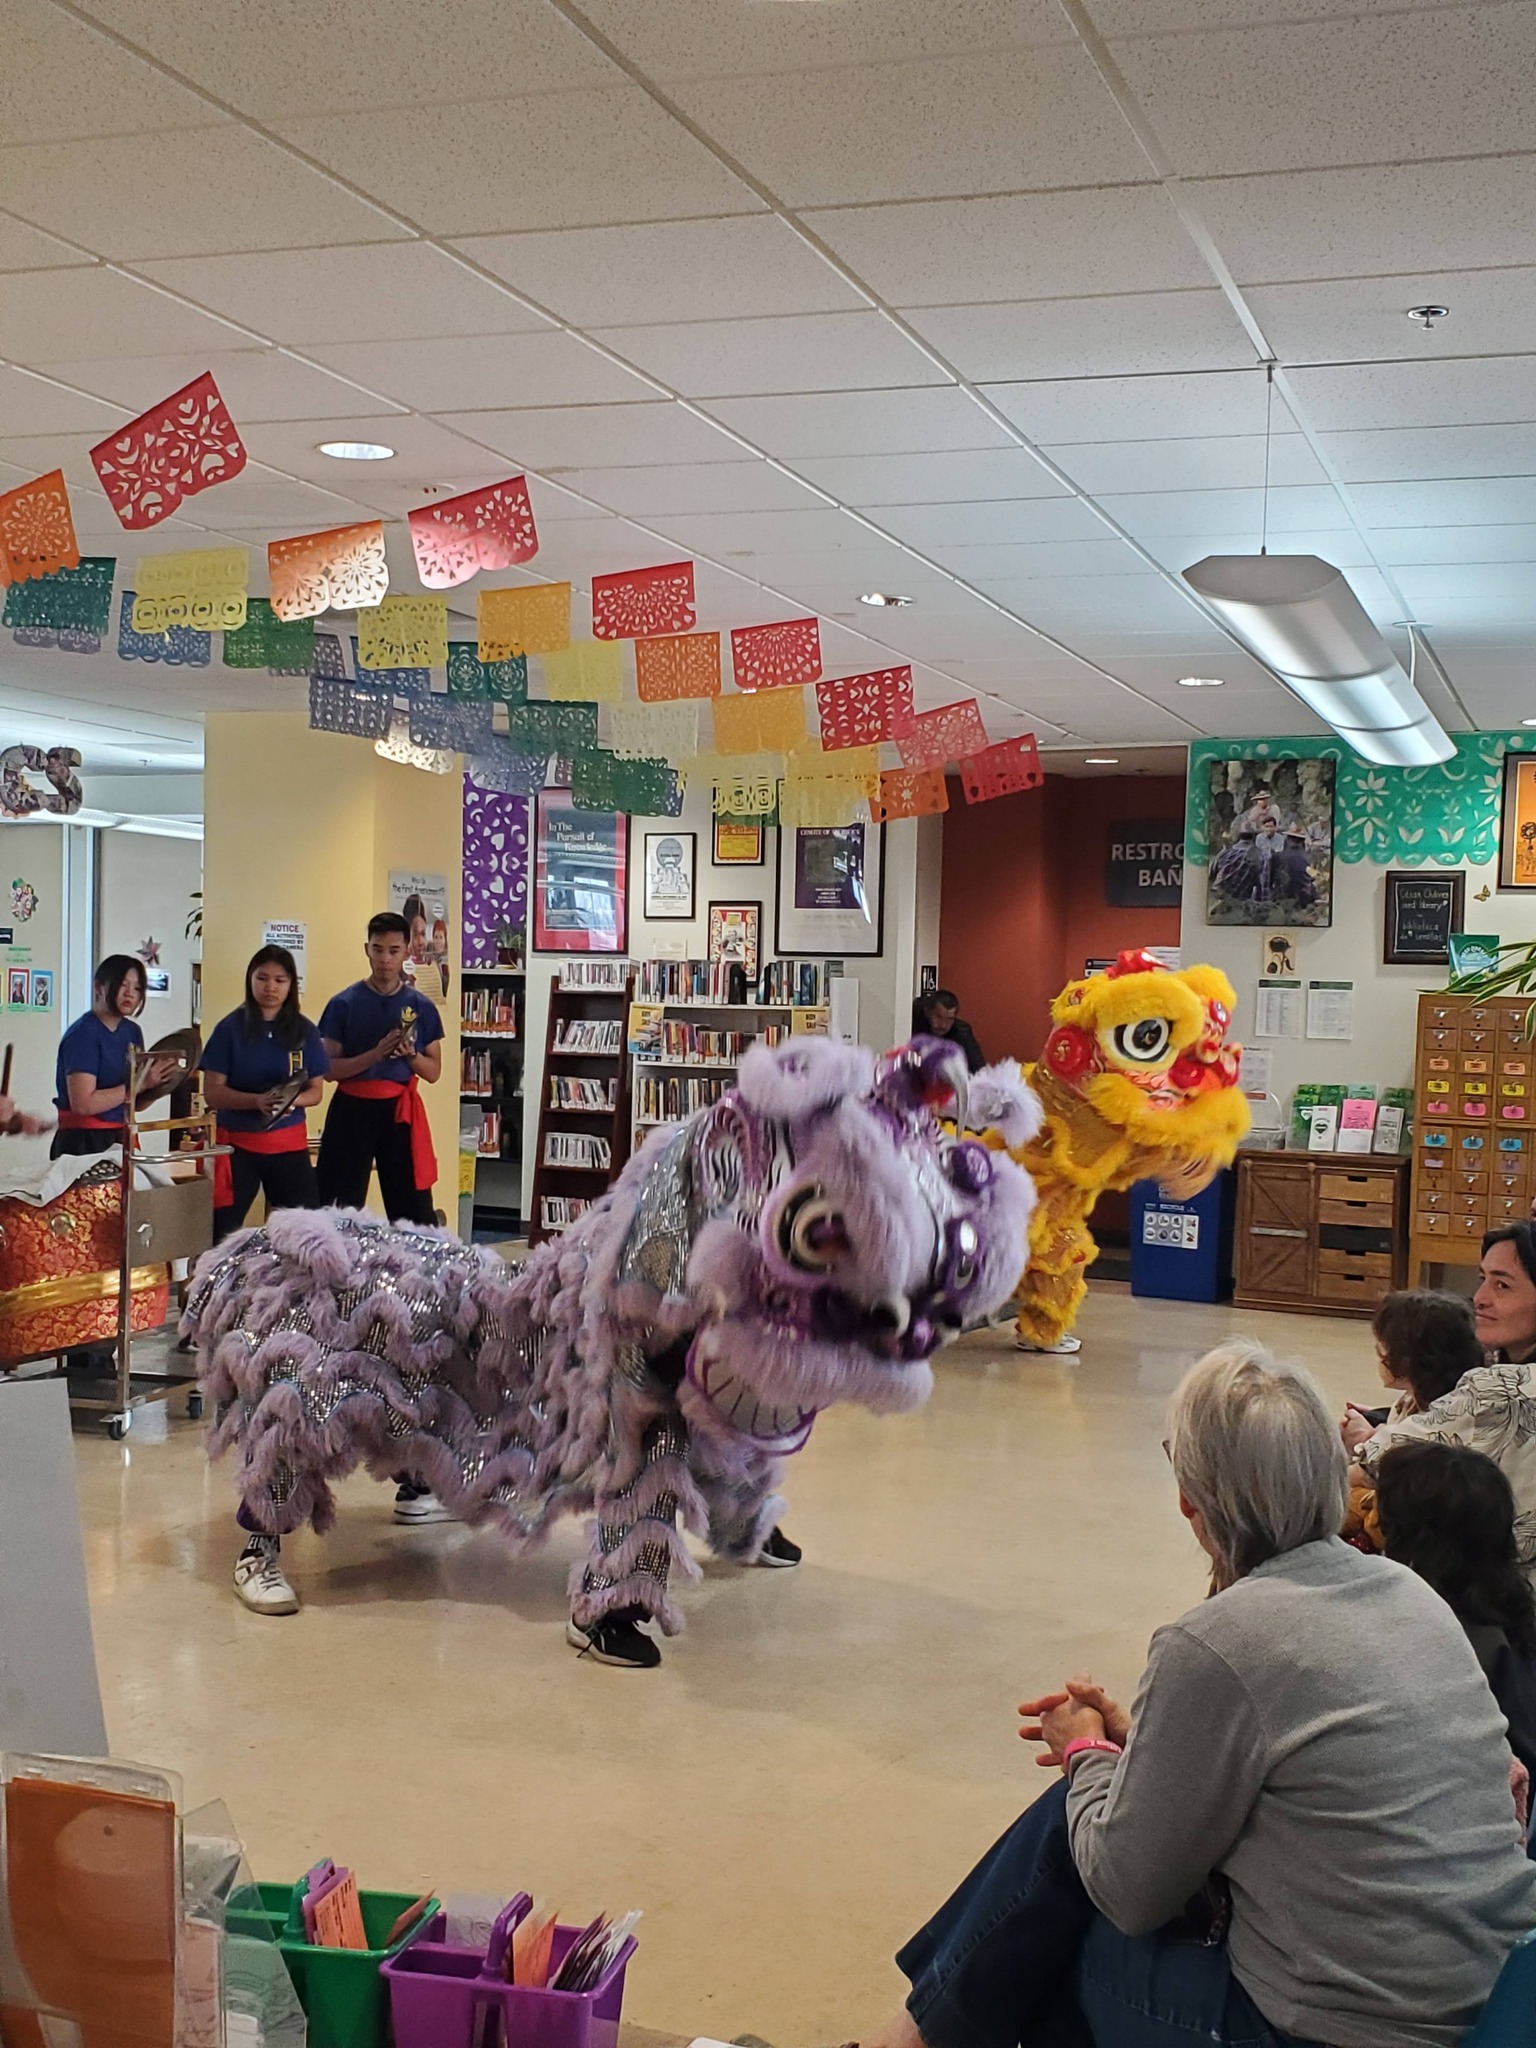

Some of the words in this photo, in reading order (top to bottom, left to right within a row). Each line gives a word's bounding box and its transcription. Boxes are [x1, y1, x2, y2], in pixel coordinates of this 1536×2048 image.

[557, 822, 573, 831] The
[556, 832, 585, 841] Pursuit
[586, 832, 595, 840] of
[1138, 864, 1183, 887] BAÑ
[270, 924, 300, 933] NOTICE
